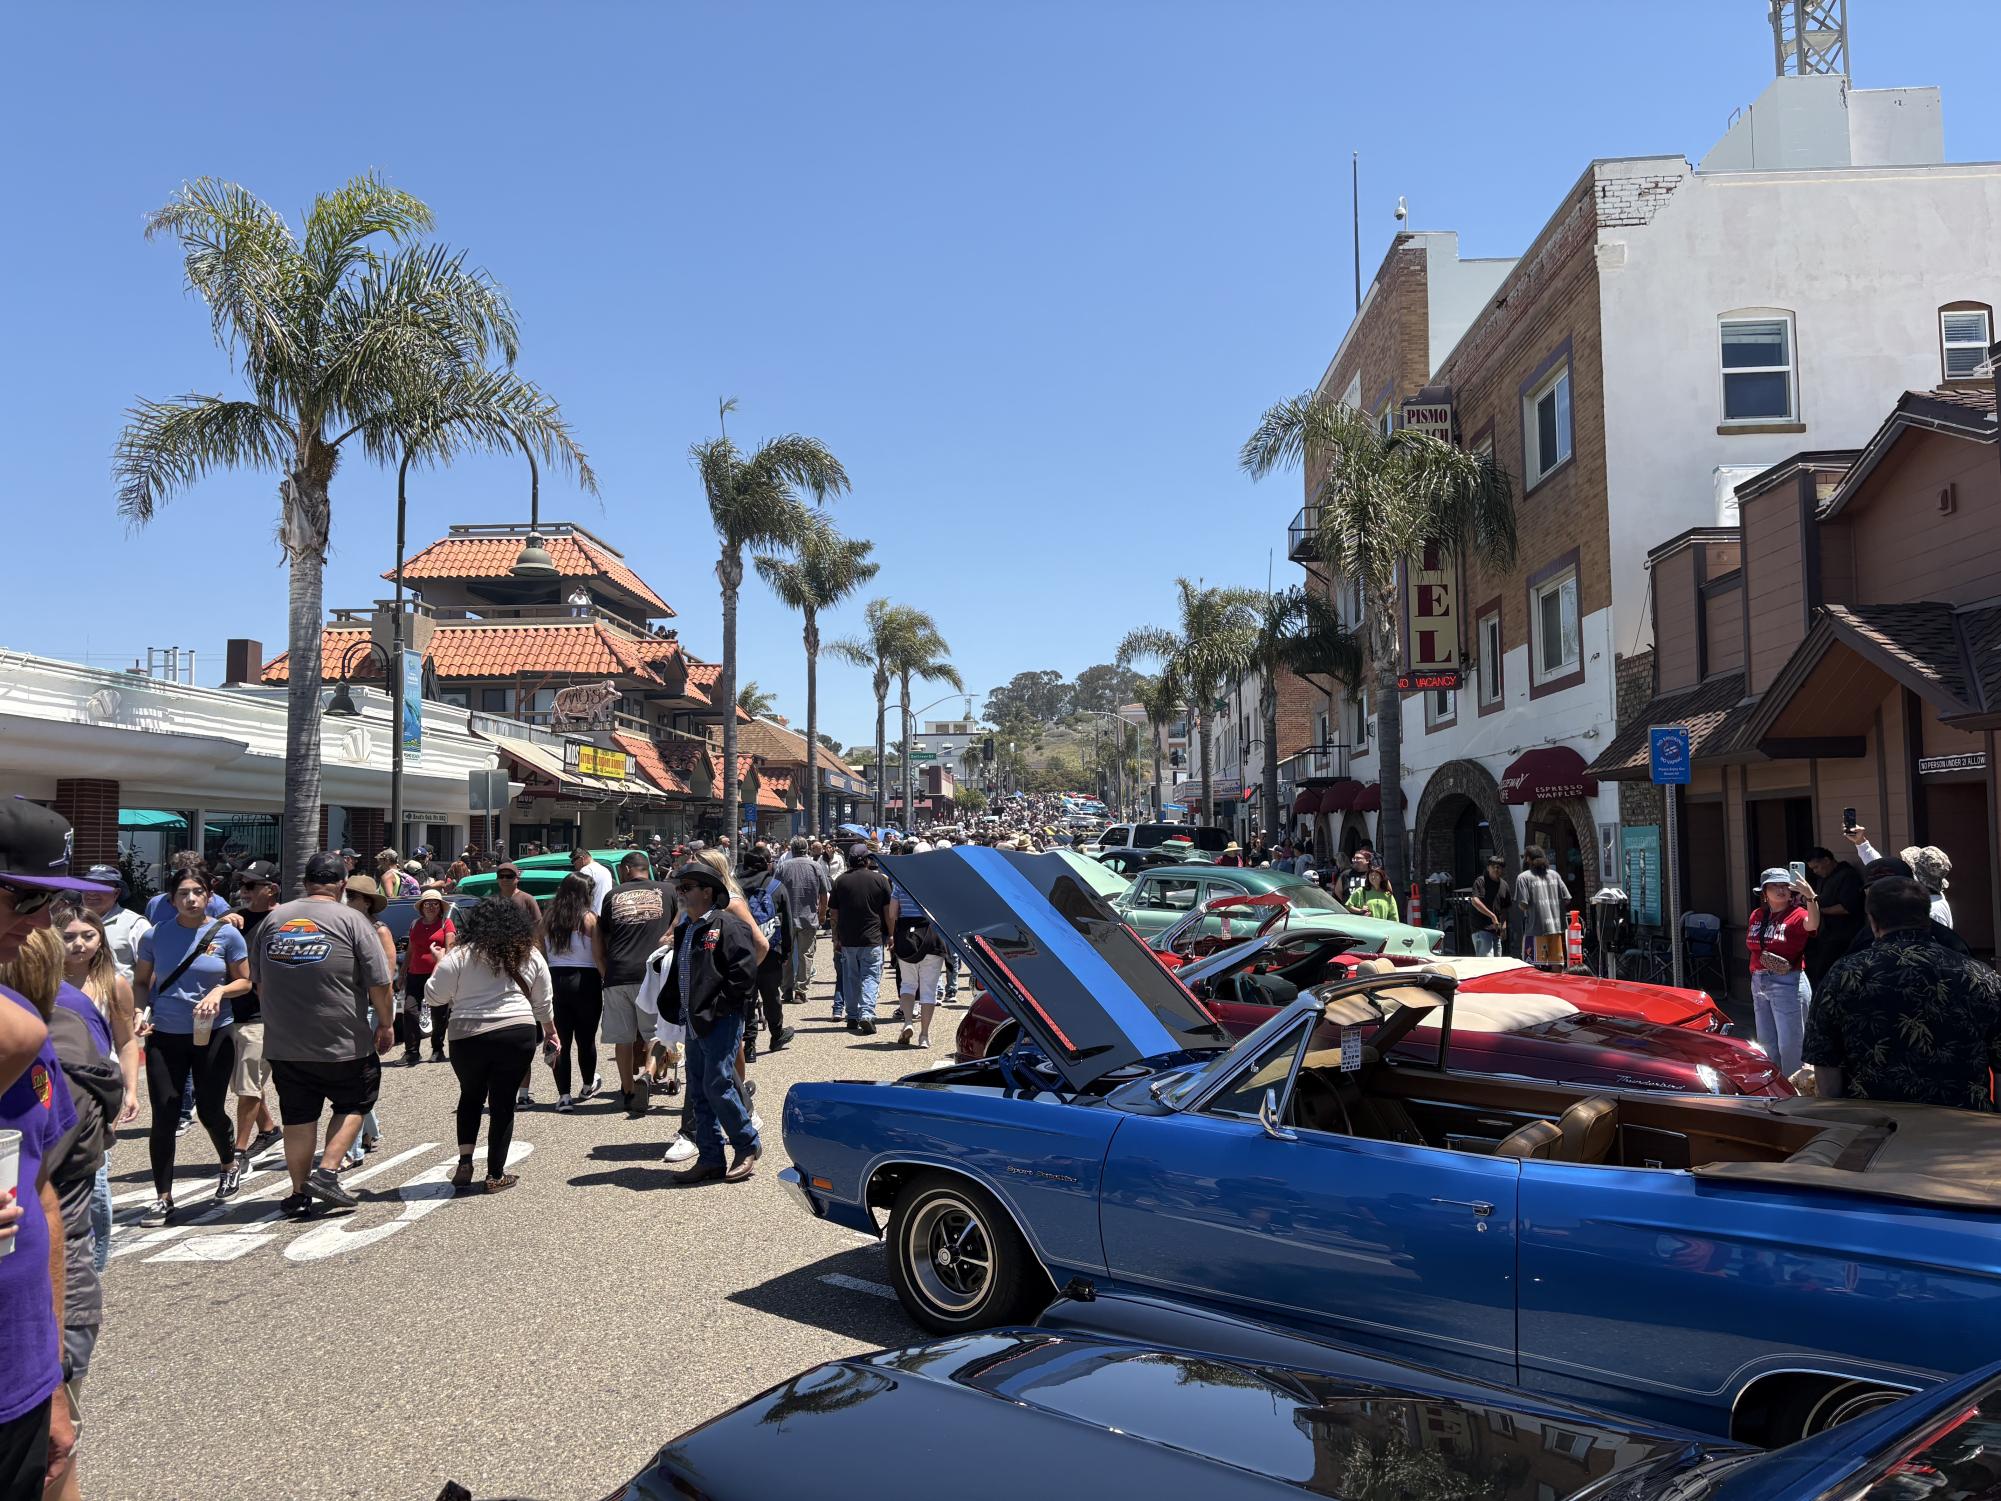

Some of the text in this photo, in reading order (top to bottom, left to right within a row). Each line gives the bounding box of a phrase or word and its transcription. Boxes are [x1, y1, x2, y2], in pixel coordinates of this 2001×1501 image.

[1407, 408, 1448, 424] PISMO
[1415, 676, 1457, 688] VACANCY
[1921, 762, 1928, 770] NO
[1928, 760, 1946, 769] PERSON
[1946, 758, 1962, 767] UNDER
[1535, 784, 1583, 793] ESPRESSO
[1536, 790, 1583, 799] WAFFLES
[268, 944, 328, 956] SEMA
